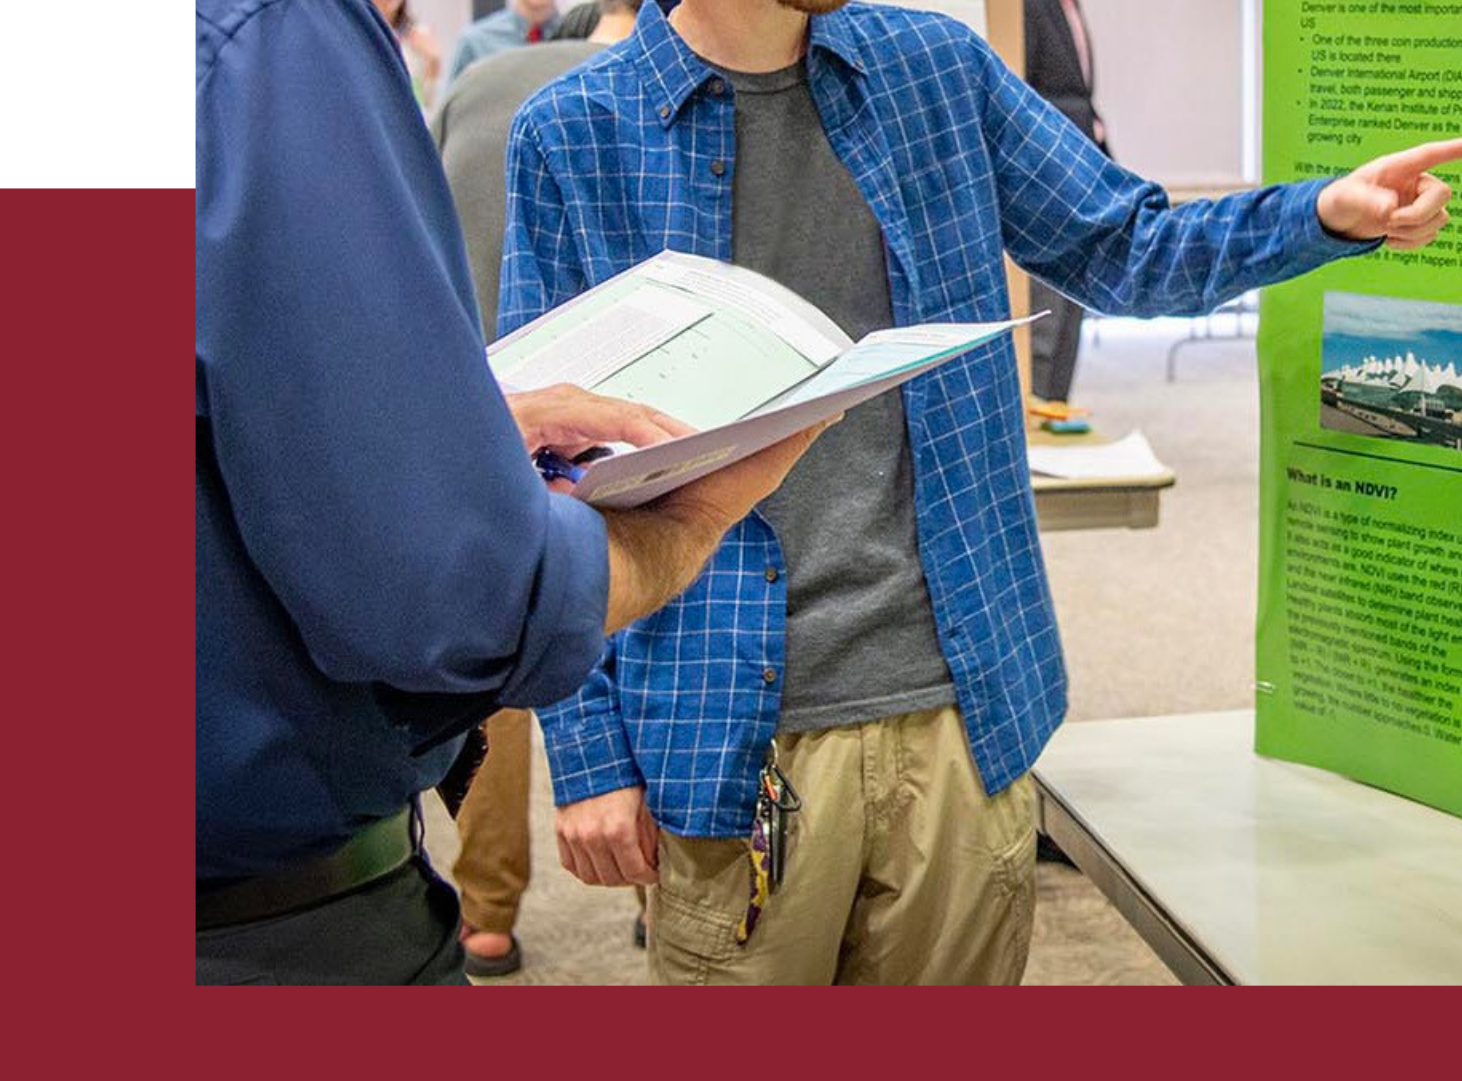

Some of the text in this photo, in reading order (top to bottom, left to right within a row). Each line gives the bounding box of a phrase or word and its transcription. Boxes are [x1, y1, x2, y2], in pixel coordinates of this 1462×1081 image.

[1301, 2, 1336, 12] Denver
[1340, 2, 1345, 12] is
[1369, 3, 1378, 13] of
[1381, 3, 1395, 13] the
[1399, 3, 1421, 13] most
[1301, 18, 1315, 28] US
[1312, 34, 1332, 44] One
[1335, 35, 1345, 45] of
[1348, 35, 1361, 45] the
[1364, 35, 1389, 46] three
[1392, 36, 1410, 46] coin
[1414, 37, 1462, 49] production
[1312, 51, 1401, 62] US is located there
[1310, 67, 1344, 78] Denver
[1348, 68, 1405, 79] International
[1409, 69, 1440, 82] Airport
[1310, 83, 1337, 96] travel,
[1341, 84, 1361, 94] both
[1364, 86, 1415, 98] passenger
[1419, 87, 1435, 96] and
[1321, 99, 1344, 112] 2022,
[1350, 101, 1363, 111] the
[1402, 103, 1438, 114] Institute
[1441, 105, 1450, 115] of
[1309, 115, 1355, 130] Enterprise
[1359, 118, 1391, 129] ranked
[1394, 119, 1429, 131] Denver
[1432, 123, 1442, 132] as
[1446, 122, 1460, 132] the
[1308, 133, 1361, 145] growing city
[1392, 252, 1420, 266] might
[1421, 254, 1458, 267] happen
[1287, 467, 1398, 499] What is an NDVI?
[1361, 515, 1370, 525] of
[1373, 519, 1426, 539] normalizing
[1429, 528, 1454, 541] index
[1413, 542, 1444, 555] growth
[1352, 546, 1373, 557] good
[1418, 559, 1427, 569] of
[1412, 574, 1426, 586] the
[1430, 580, 1445, 590] red
[1400, 587, 1423, 601] band
[1412, 624, 1425, 636] the
[1420, 642, 1429, 652] of
[1432, 644, 1446, 657] the
[1424, 661, 1439, 673] the
[1421, 678, 1432, 688] an
[1435, 680, 1460, 693] index
[1438, 696, 1452, 709] the
